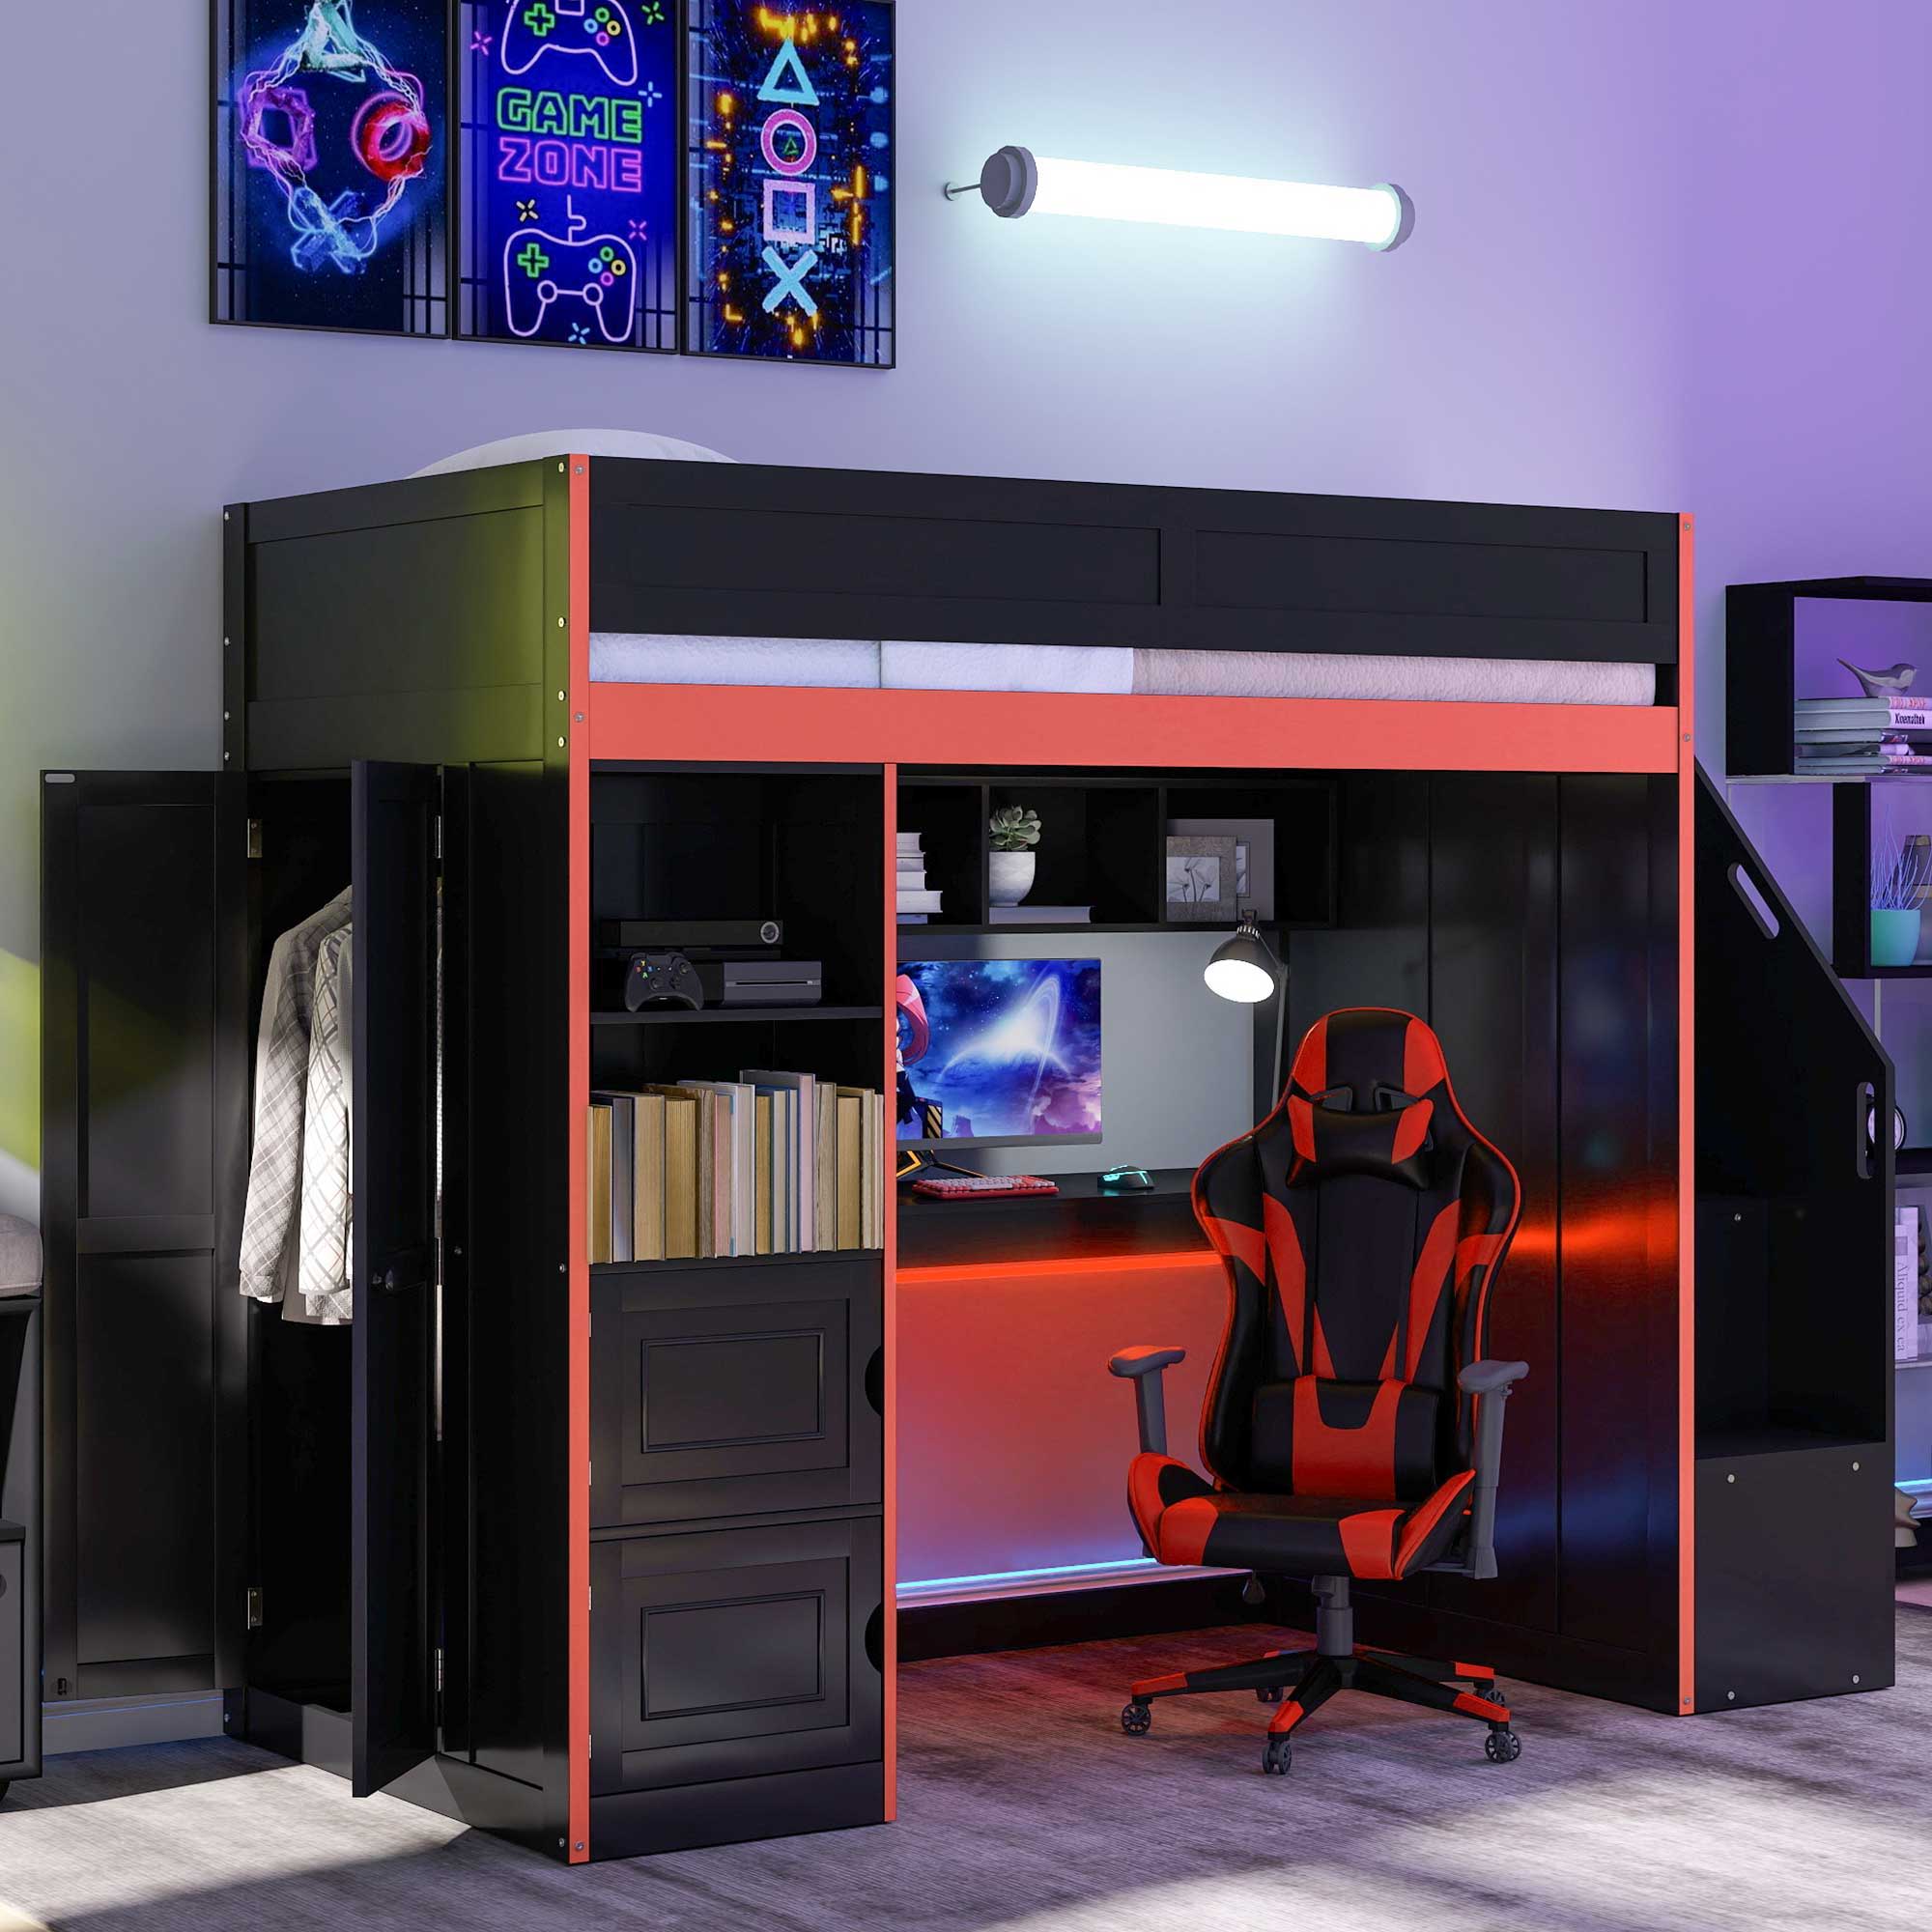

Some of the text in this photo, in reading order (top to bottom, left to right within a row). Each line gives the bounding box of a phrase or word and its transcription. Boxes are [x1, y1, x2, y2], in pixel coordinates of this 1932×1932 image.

[497, 87, 641, 143] GAME
[498, 136, 641, 192] ZONE
[1895, 1262, 1908, 1312] Aliquid
